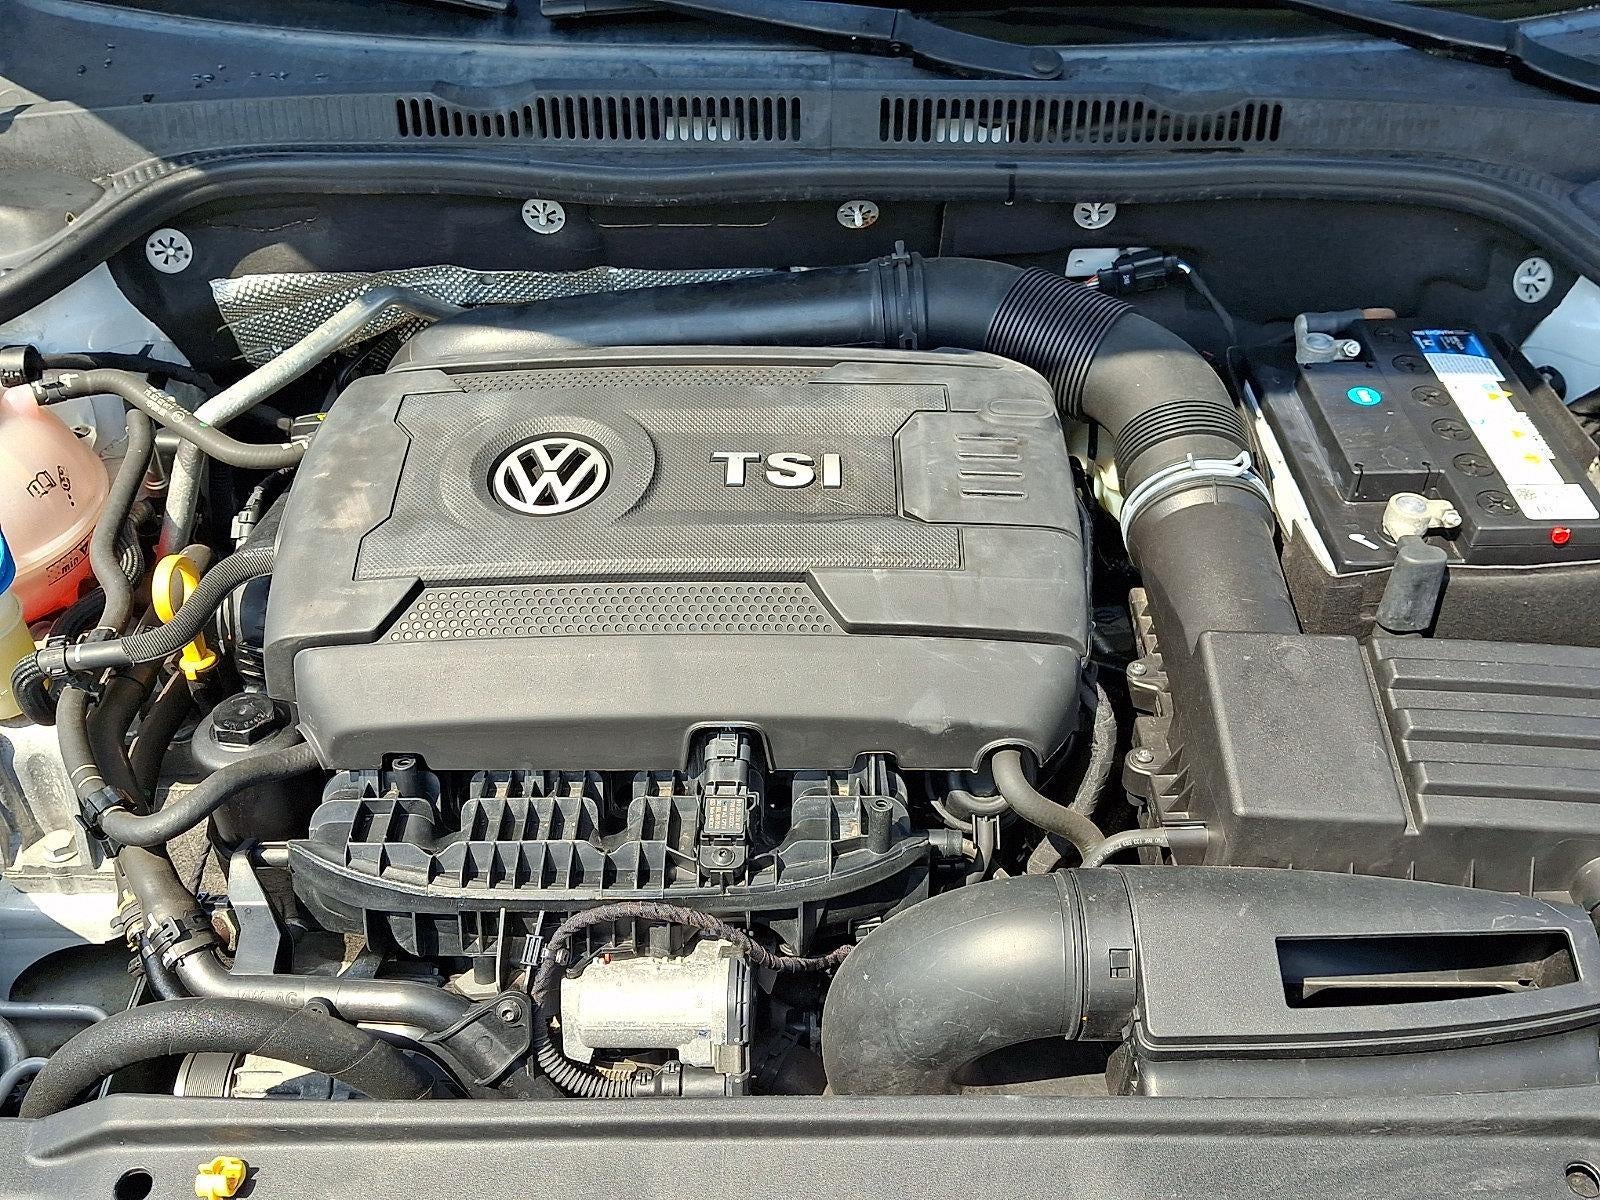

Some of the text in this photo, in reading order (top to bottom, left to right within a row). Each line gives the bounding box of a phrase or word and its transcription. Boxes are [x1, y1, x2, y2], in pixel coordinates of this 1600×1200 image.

[493, 437, 610, 516] VW
[710, 451, 843, 490] TSI
[61, 556, 79, 575] min
